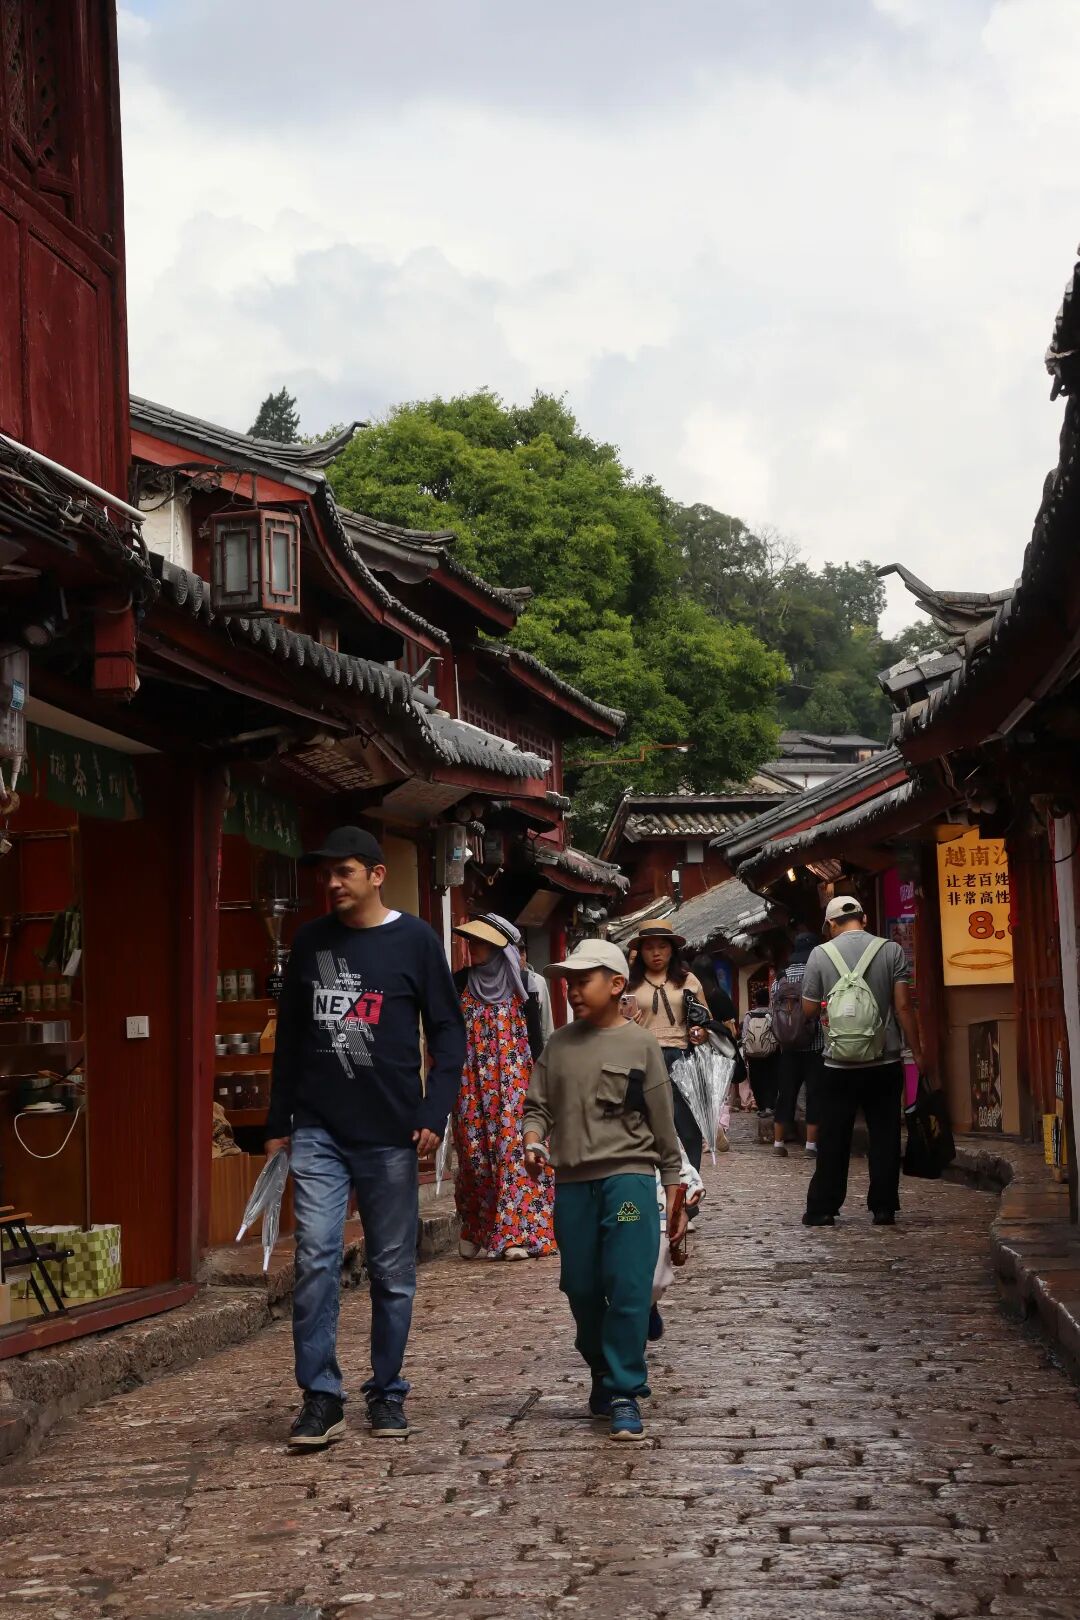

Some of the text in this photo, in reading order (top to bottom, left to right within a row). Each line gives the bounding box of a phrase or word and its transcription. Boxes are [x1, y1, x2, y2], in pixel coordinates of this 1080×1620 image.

[946, 872, 1009, 888] 让老百姓
[315, 994, 377, 1018] NEXT
[319, 1016, 368, 1032] LEVEL
